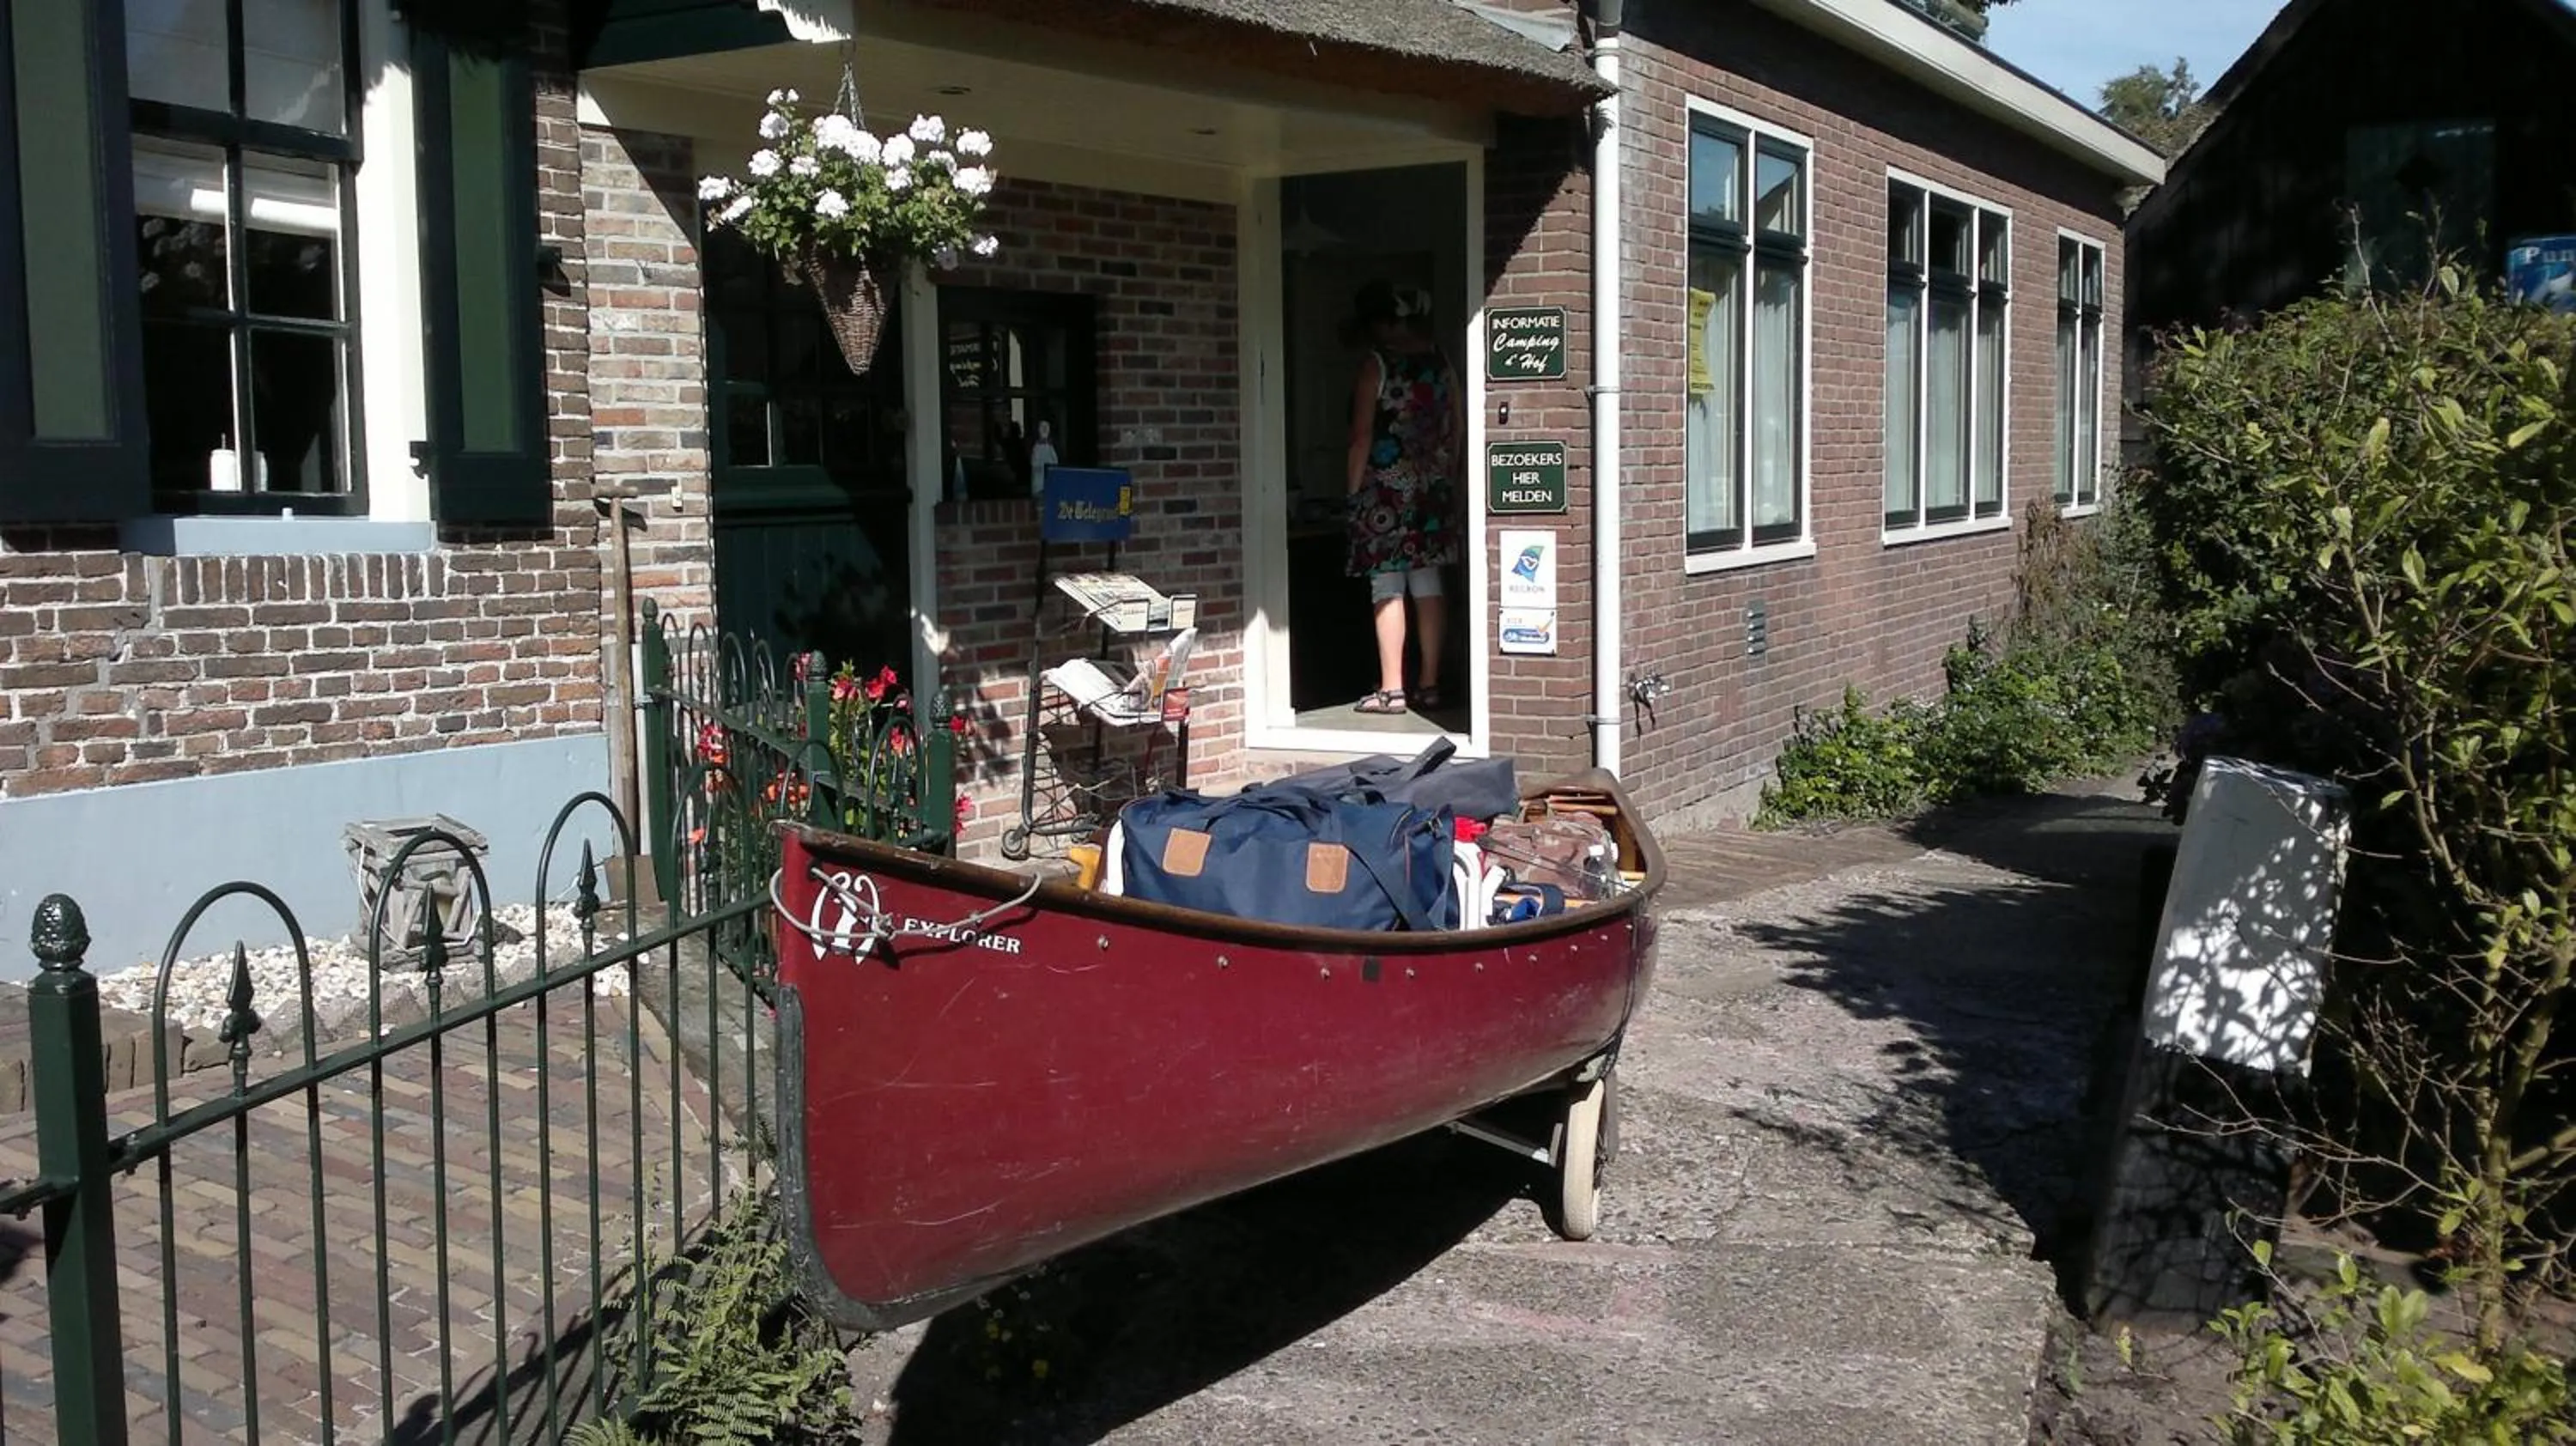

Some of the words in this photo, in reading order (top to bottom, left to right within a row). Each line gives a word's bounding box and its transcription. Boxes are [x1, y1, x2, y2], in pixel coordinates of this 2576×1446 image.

[1493, 316, 1560, 330] INFORMATIE
[1493, 332, 1559, 353] Camping
[1492, 453, 1562, 466] BEZOEKERS
[1512, 471, 1540, 484] HIER
[1502, 490, 1552, 503] MELDEN
